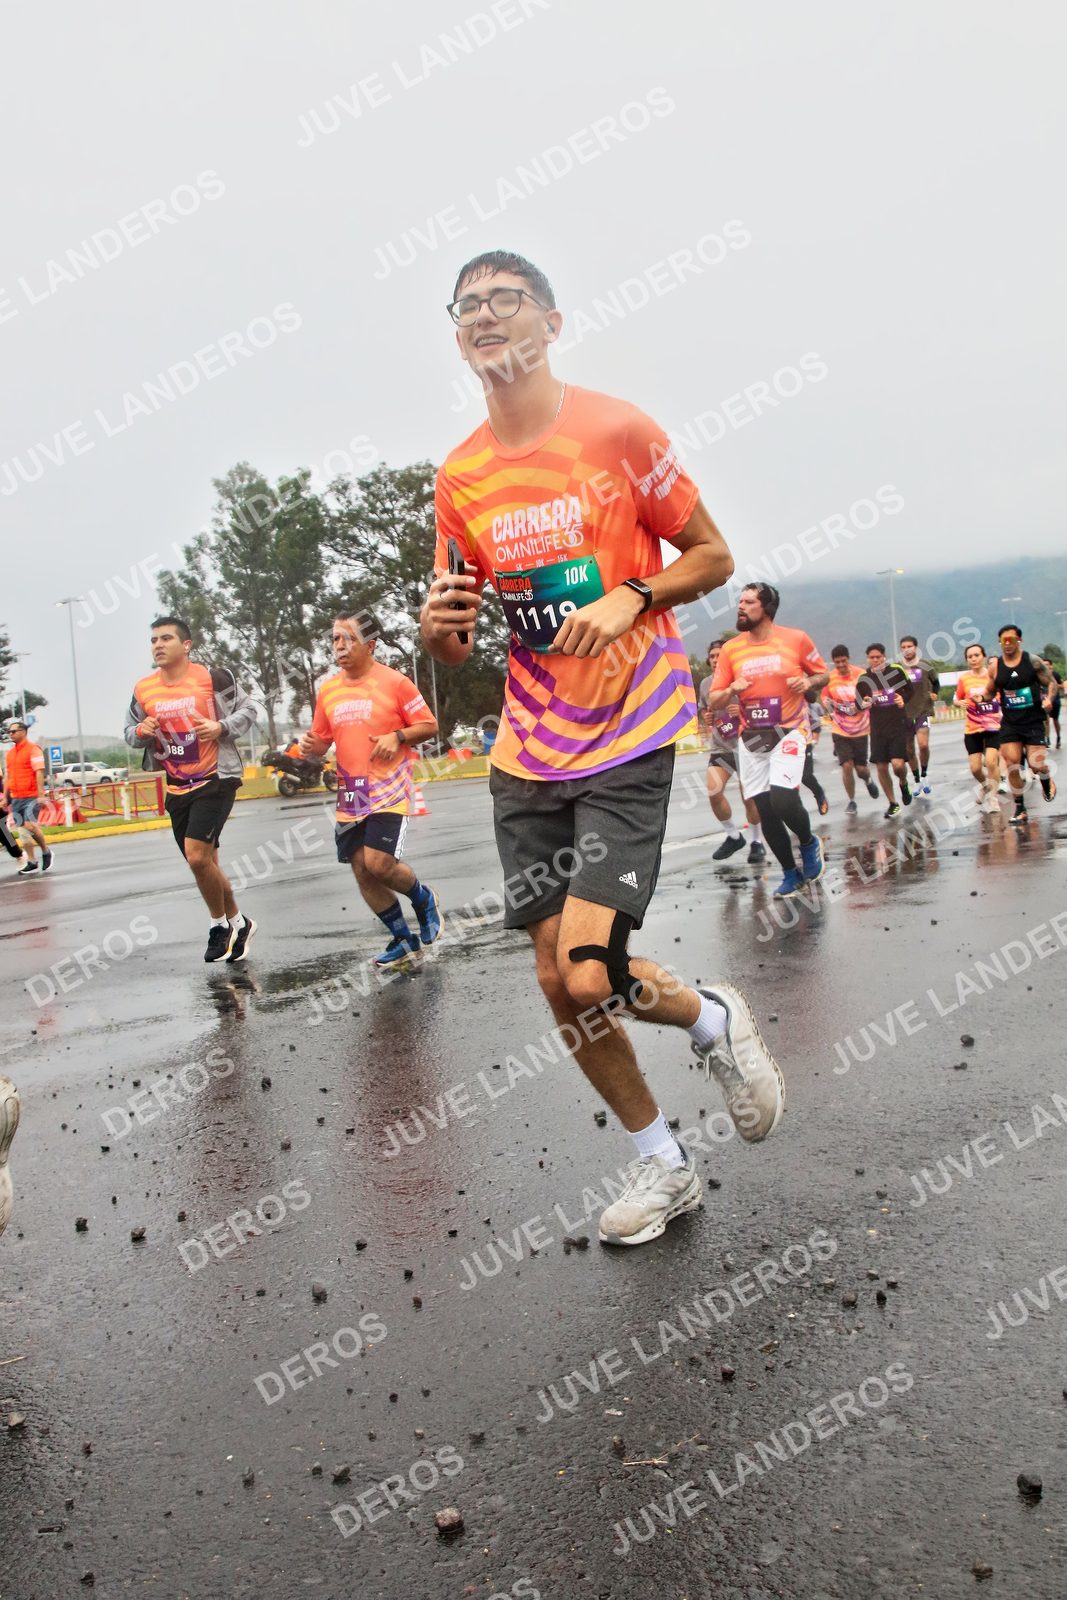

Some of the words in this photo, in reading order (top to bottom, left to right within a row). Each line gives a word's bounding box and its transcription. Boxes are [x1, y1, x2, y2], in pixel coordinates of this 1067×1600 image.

[492, 496, 582, 543] CARRERA
[499, 576, 532, 591] CARRERA
[564, 564, 589, 587] 10K
[751, 708, 769, 719] 622
